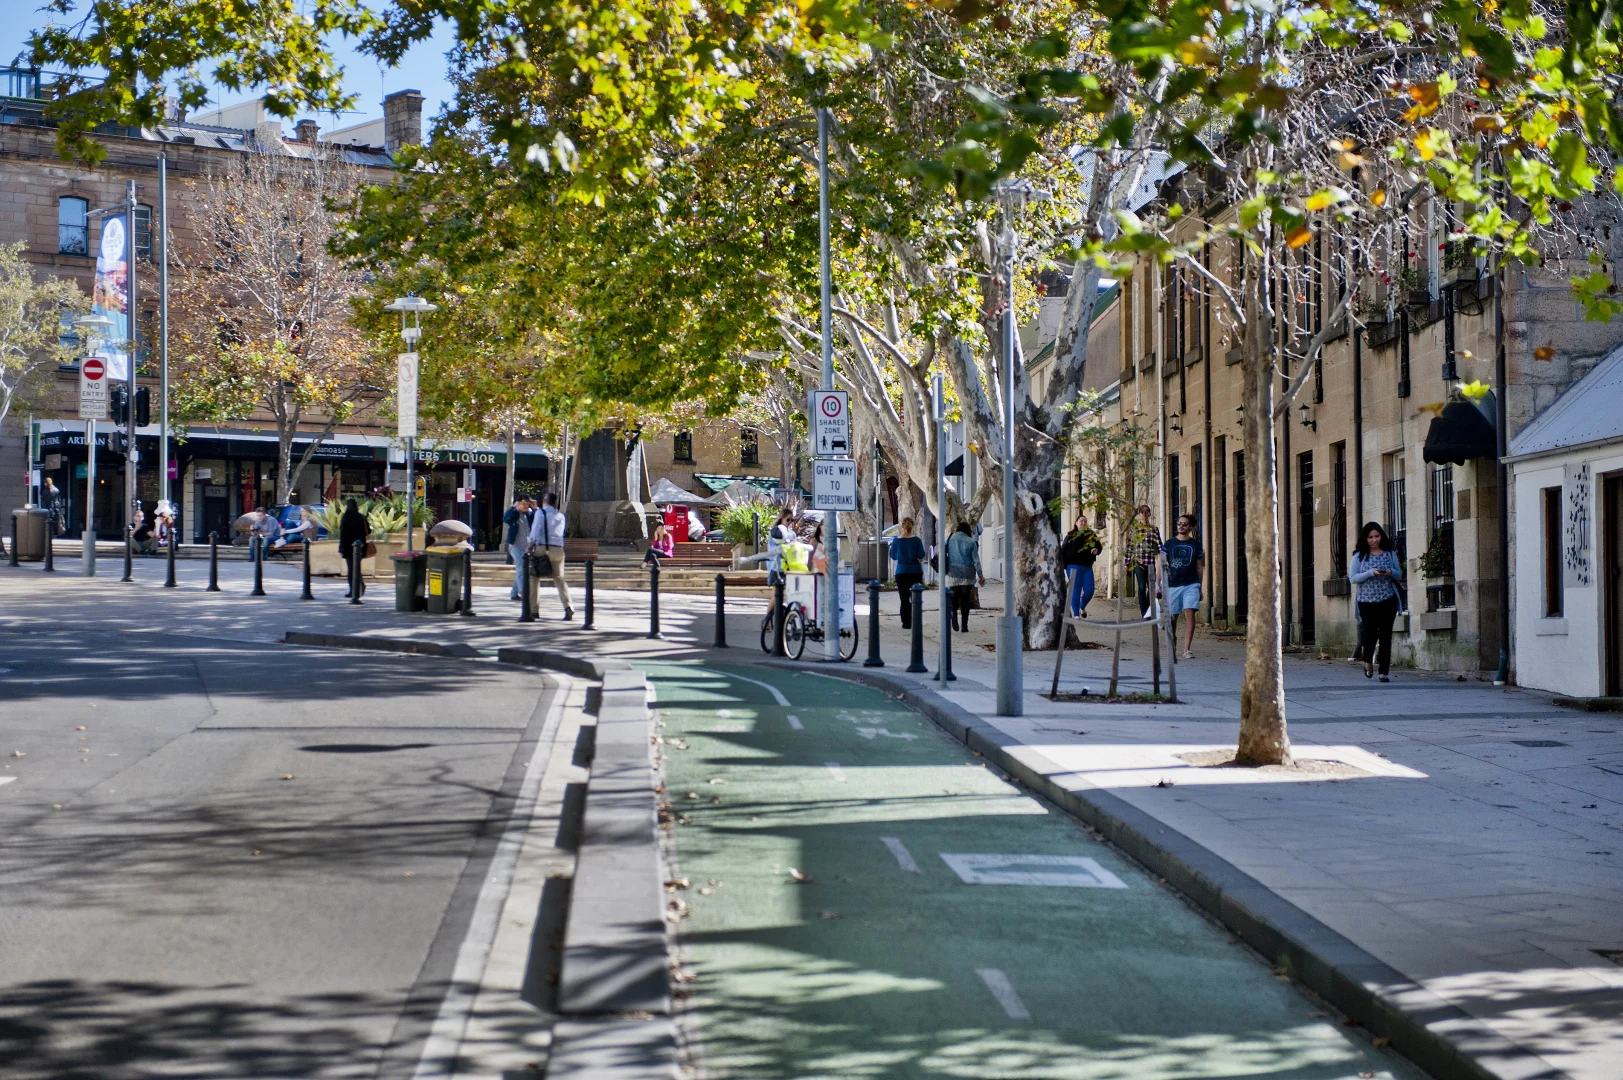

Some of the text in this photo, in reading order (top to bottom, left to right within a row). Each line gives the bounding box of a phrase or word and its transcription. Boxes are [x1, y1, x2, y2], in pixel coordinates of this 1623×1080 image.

[826, 401, 837, 412] 10
[448, 452, 495, 464] LIQUOR
[816, 465, 854, 476] GIVE WAY
[830, 480, 840, 491] TO
[817, 494, 853, 505] PEDESTRIANS
